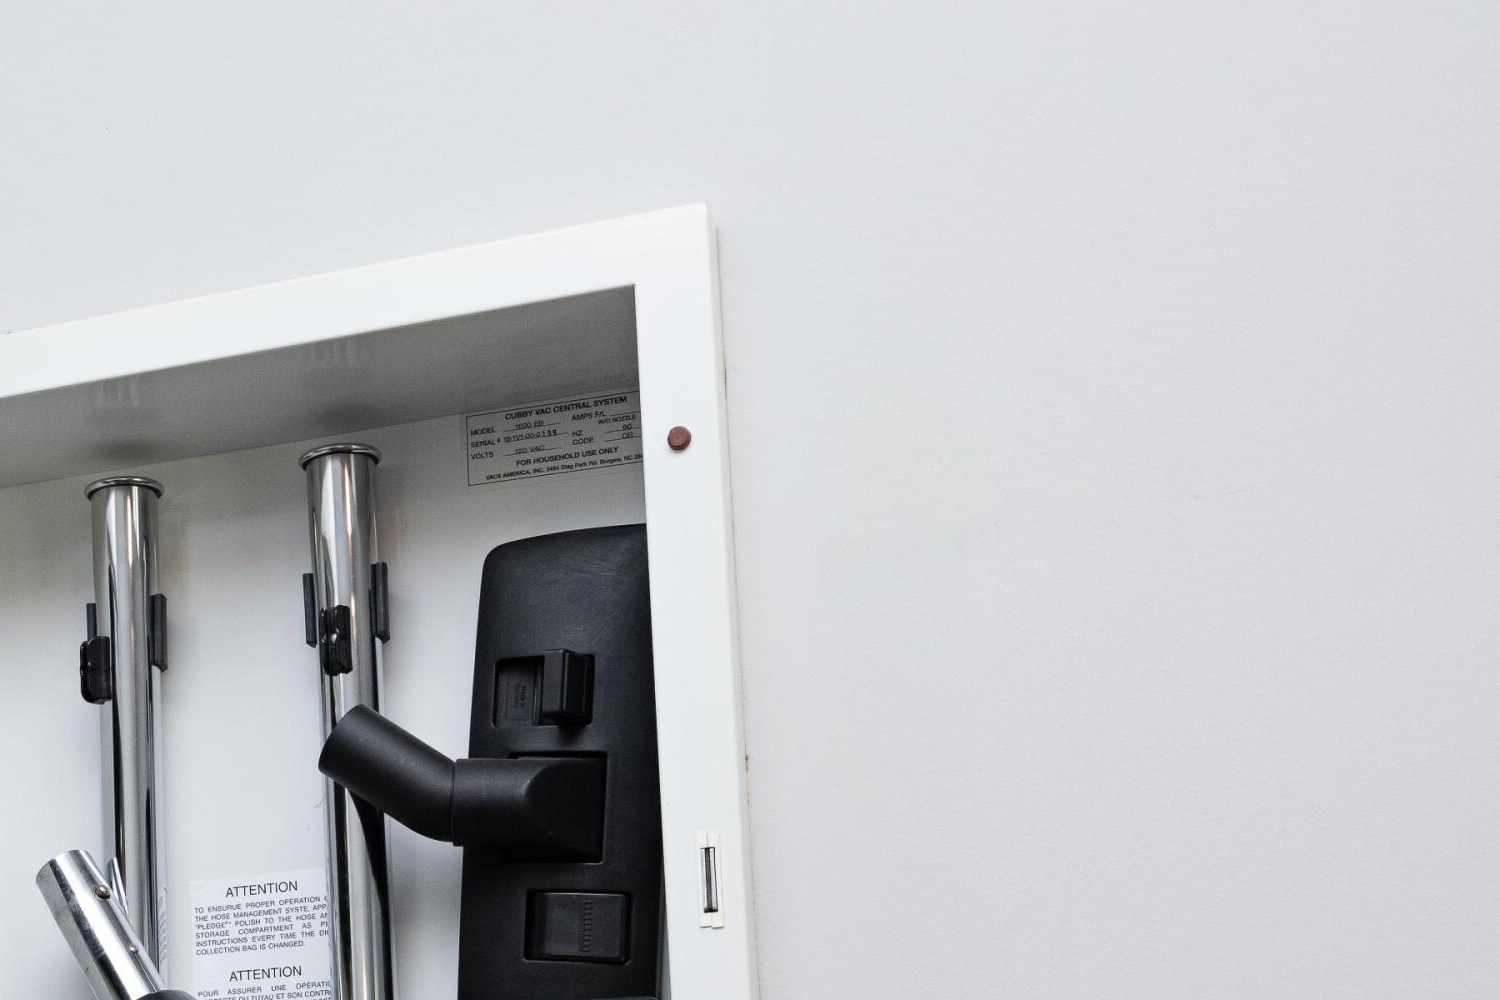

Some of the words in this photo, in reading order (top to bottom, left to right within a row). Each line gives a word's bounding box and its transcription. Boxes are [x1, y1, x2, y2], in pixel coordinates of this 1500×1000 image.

[505, 410, 534, 420] CUBBY
[536, 407, 551, 416] VAC
[553, 401, 591, 413] CENTRAL
[593, 396, 627, 407] SYSTEM
[571, 412, 593, 421] AMPS
[612, 414, 636, 423] NOZZLE
[470, 427, 496, 435] MODEL
[470, 439, 495, 448] SERIAL
[572, 437, 594, 445] CODE
[470, 451, 494, 460] VOLTS
[516, 458, 532, 467] FOR
[533, 452, 580, 465] HOUSEHOLD
[581, 449, 596, 458] USE
[597, 446, 619, 456] ONLY
[225, 880, 298, 898] ATTENTION
[207, 904, 241, 913] ENSURUE
[245, 901, 275, 909] PROPER
[278, 896, 320, 906] OPERATION
[233, 908, 283, 919] MANAGEMENT
[312, 903, 327, 911] APP
[234, 919, 261, 927] POLISH
[195, 930, 230, 939] STORAGE
[238, 924, 294, 935] COMPARTMENT
[196, 937, 248, 947] INSTRUCTIONS
[251, 934, 276, 943] EVERY
[280, 932, 297, 940] TIME
[196, 945, 240, 956] COLLECTION
[229, 965, 302, 982] ATTENTION
[227, 986, 262, 995] ASSURER
[251, 992, 274, 1000] TUYAU
[287, 991, 302, 999] SON
[304, 989, 331, 997] CONTR
